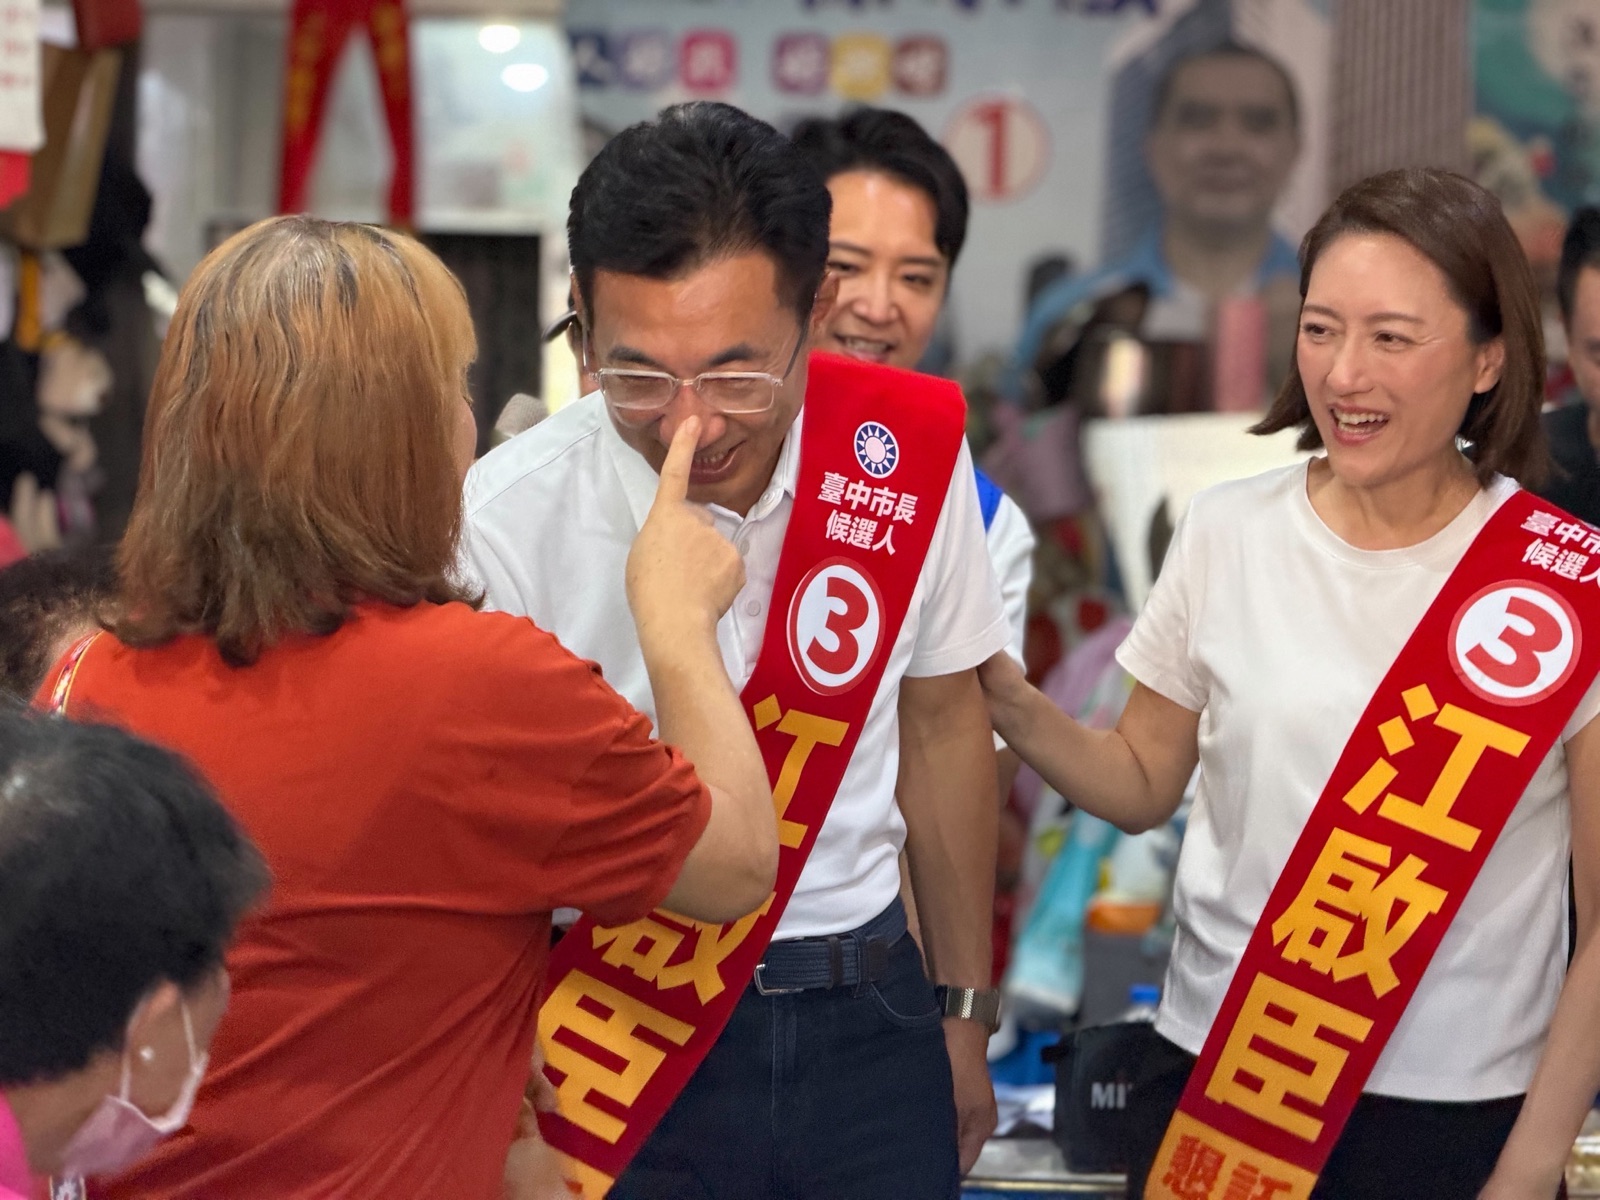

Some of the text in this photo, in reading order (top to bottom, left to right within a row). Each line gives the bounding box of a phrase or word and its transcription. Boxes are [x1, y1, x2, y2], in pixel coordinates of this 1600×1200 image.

[972, 102, 1007, 197] 1
[817, 471, 918, 525] 臺中市長
[825, 509, 896, 556] 候選人
[1521, 537, 1600, 589] 候選人
[806, 576, 869, 675] 3
[1464, 596, 1563, 688] 3
